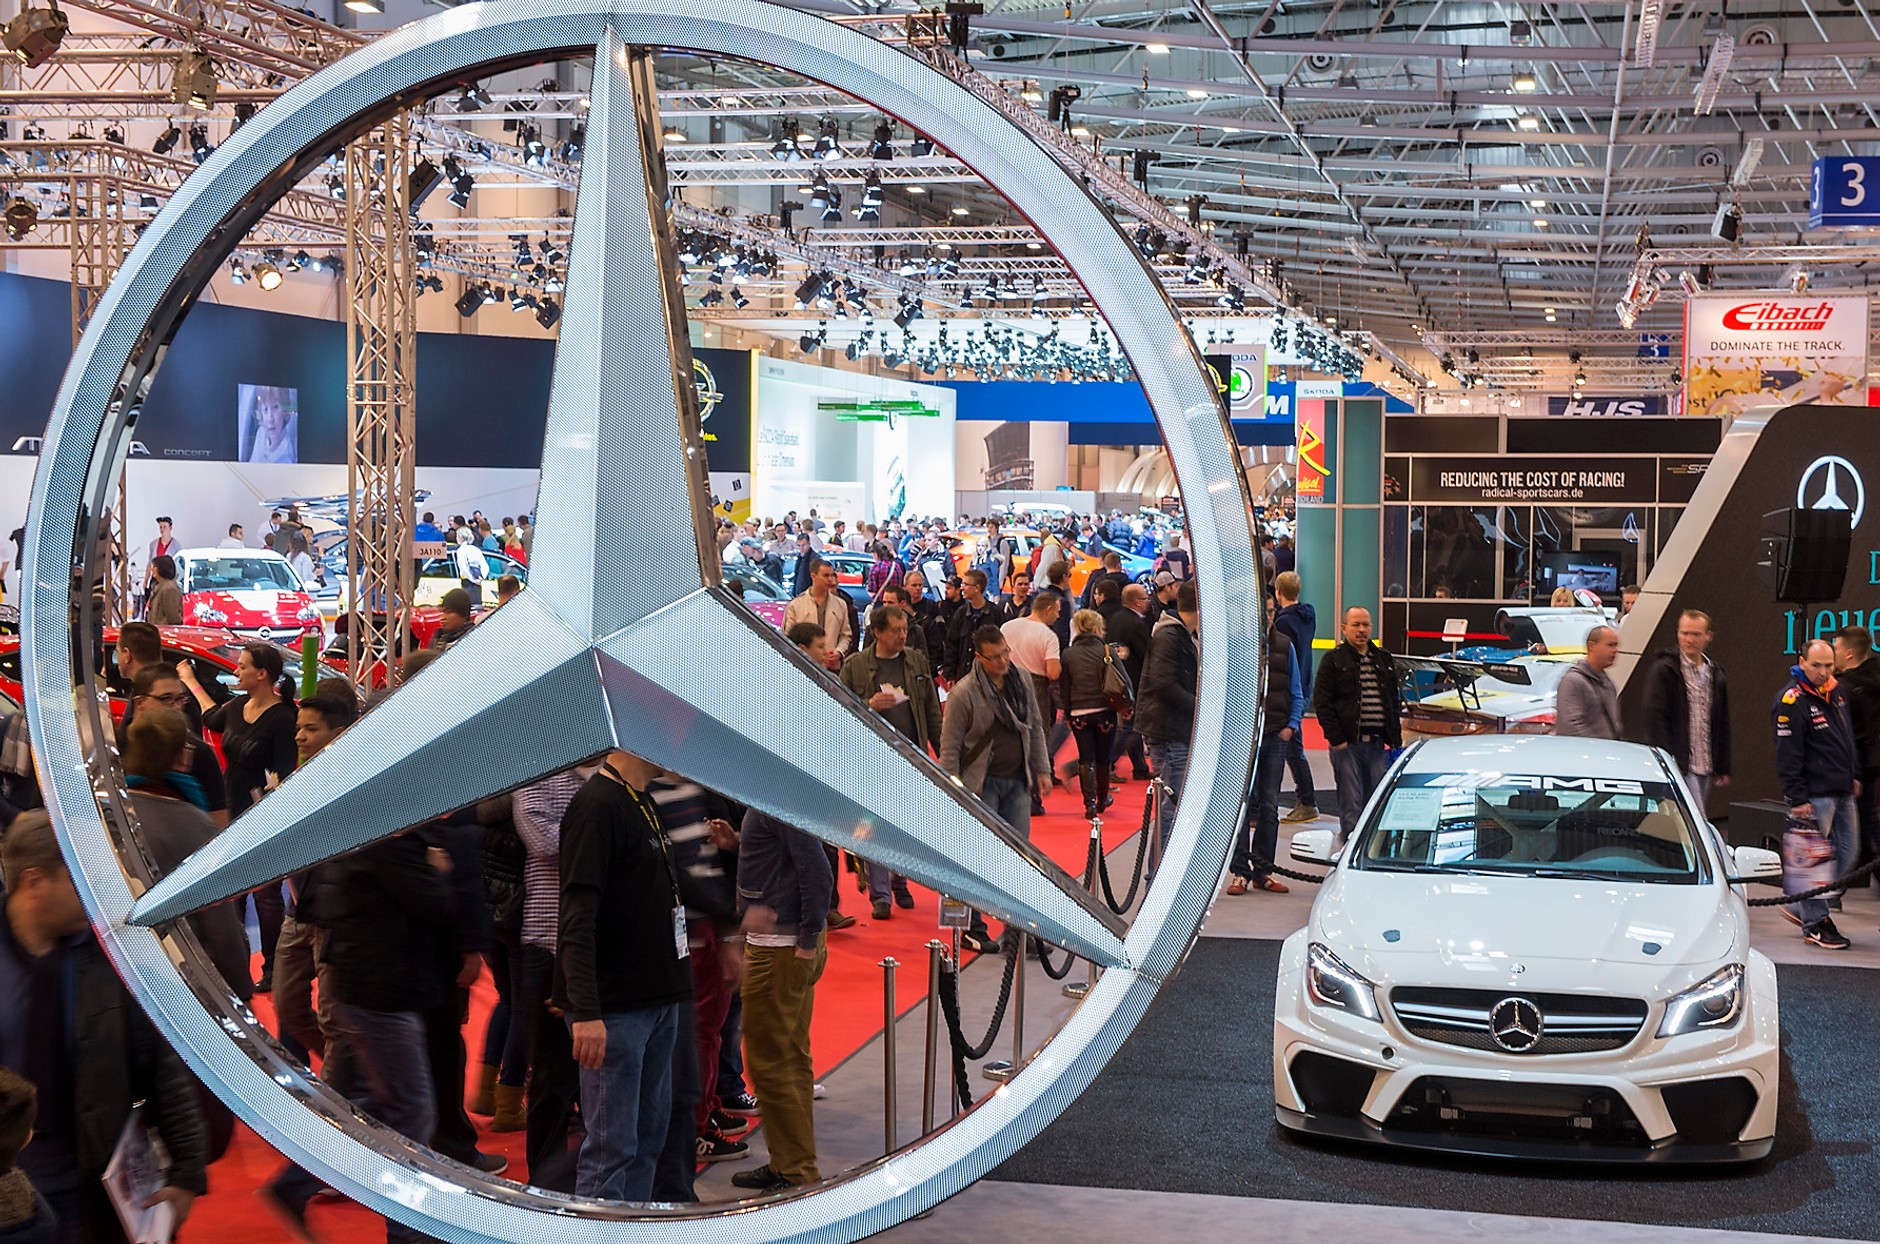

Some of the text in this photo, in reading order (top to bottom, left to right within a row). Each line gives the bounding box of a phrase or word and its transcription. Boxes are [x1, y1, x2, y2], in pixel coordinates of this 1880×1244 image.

[1813, 167, 1820, 210] 3
[1841, 162, 1866, 207] 3
[1722, 302, 1834, 331] Eibach
[1710, 340, 1845, 351] DOMINATE THE TRACK.
[1563, 401, 1646, 416] HJS
[163, 448, 212, 457] CONCEPT
[1440, 471, 1625, 488] REDUCING THE COST OF RACING!
[1481, 487, 1584, 499] radical-sportscars.de
[419, 548, 442, 556] 3A110
